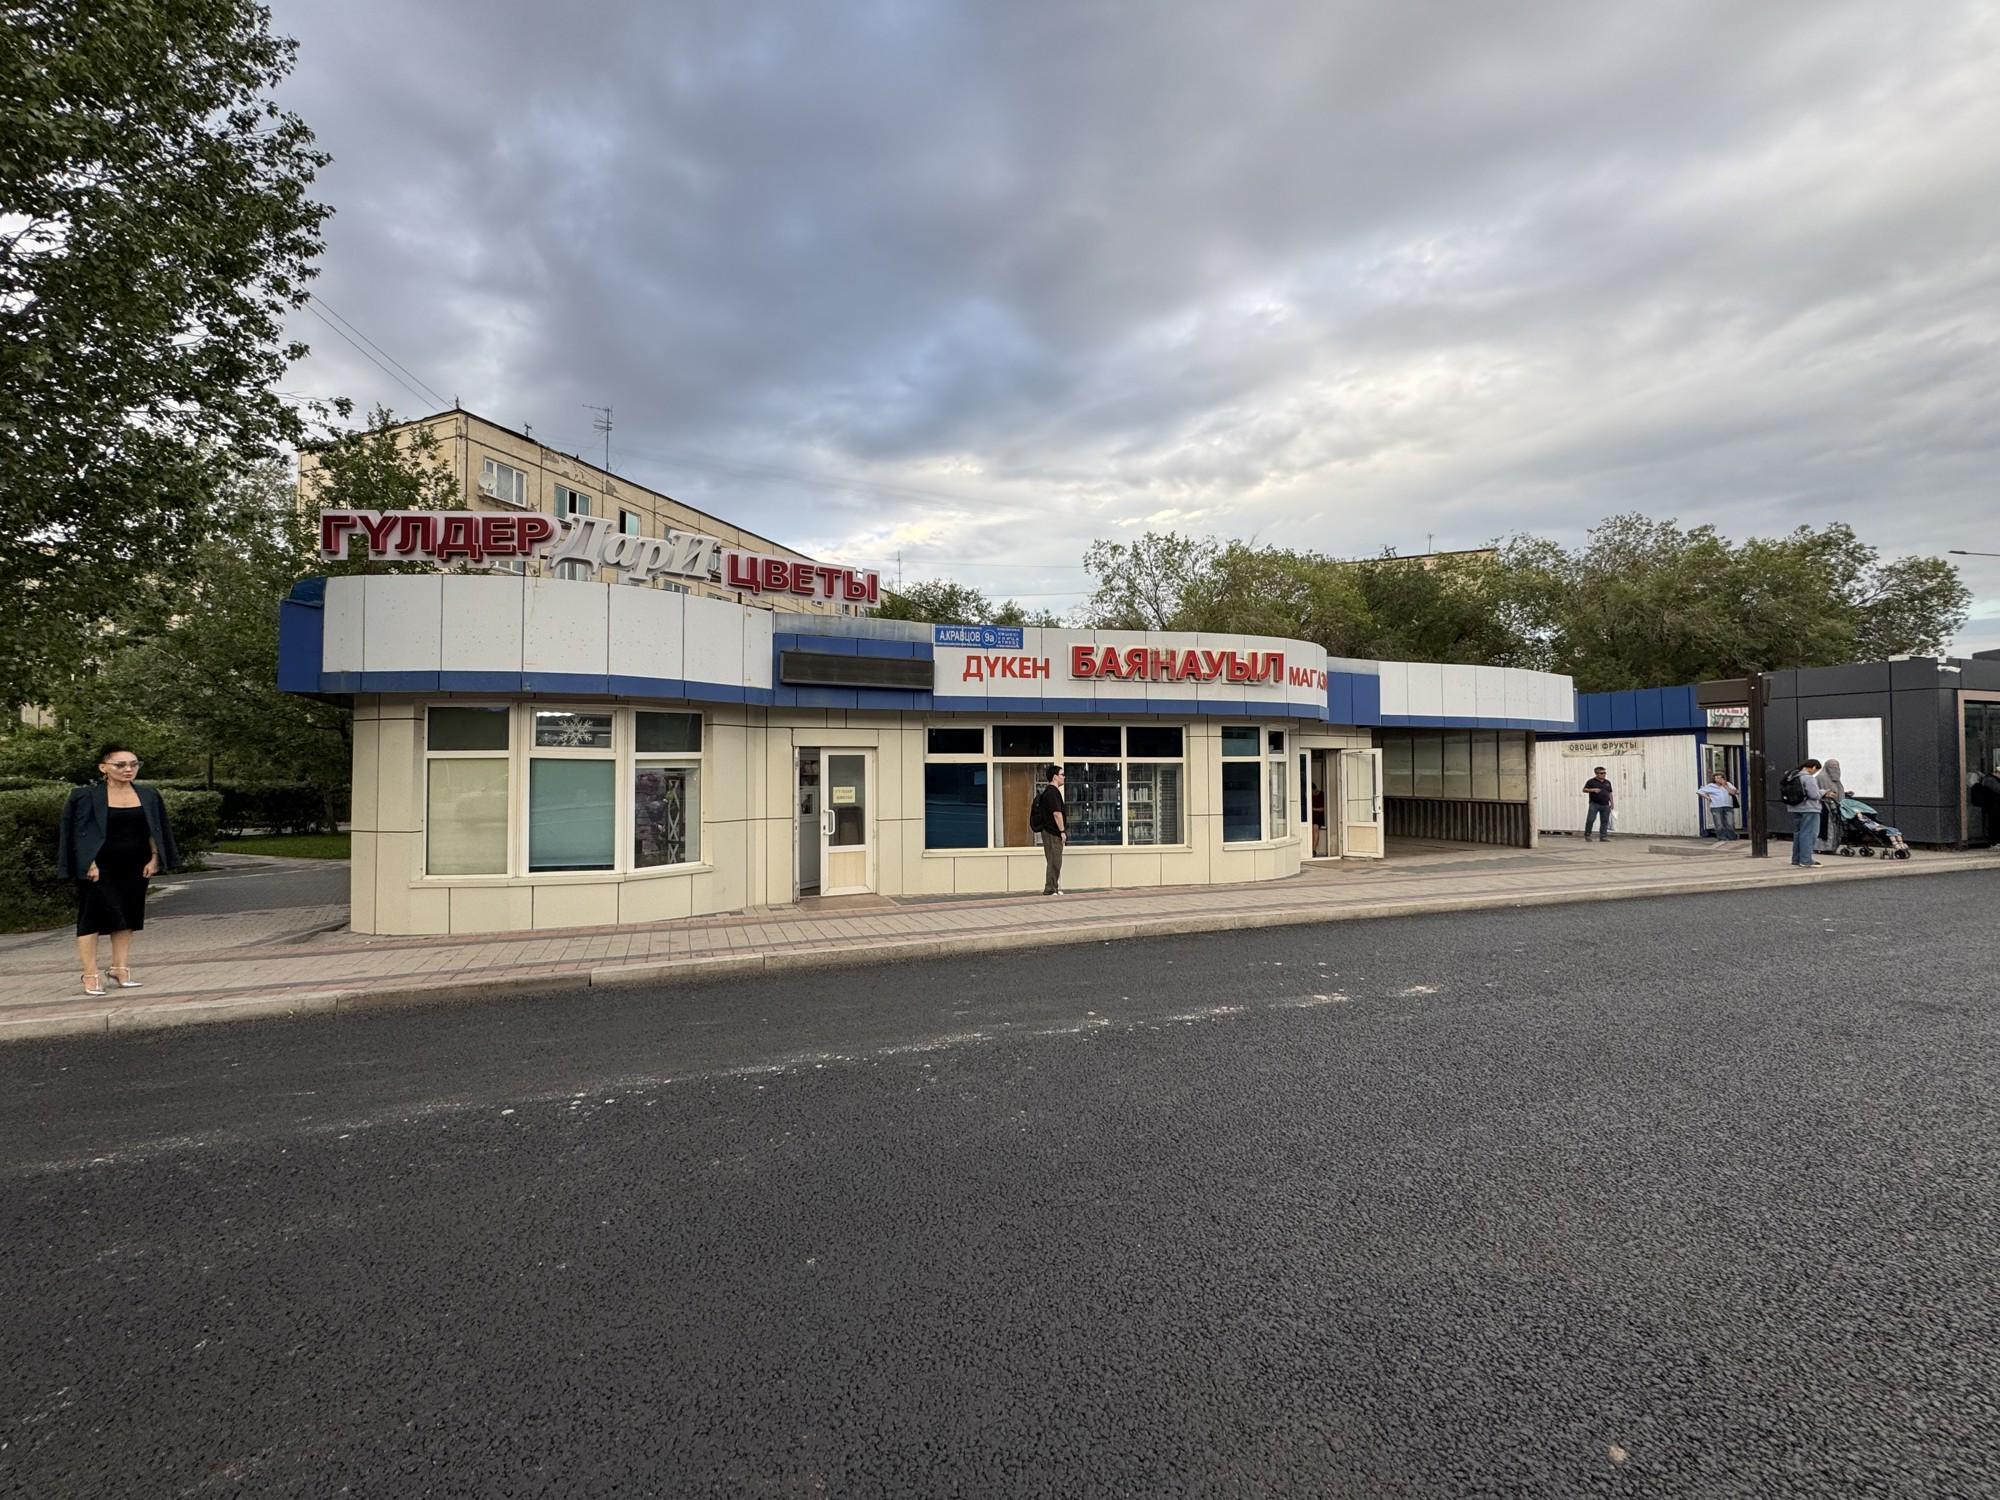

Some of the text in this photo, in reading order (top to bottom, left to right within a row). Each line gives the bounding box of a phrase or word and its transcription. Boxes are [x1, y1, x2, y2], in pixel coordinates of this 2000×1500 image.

[322, 515, 553, 561] ГҮЛДЕР
[727, 554, 878, 602] ЦВЕТЫ
[963, 655, 1050, 682] ДҮКЕН
[1070, 645, 1285, 683] БАЯНАУЫЛ
[1569, 741, 1637, 752] ОВОЩИ ФРУКТЫ
